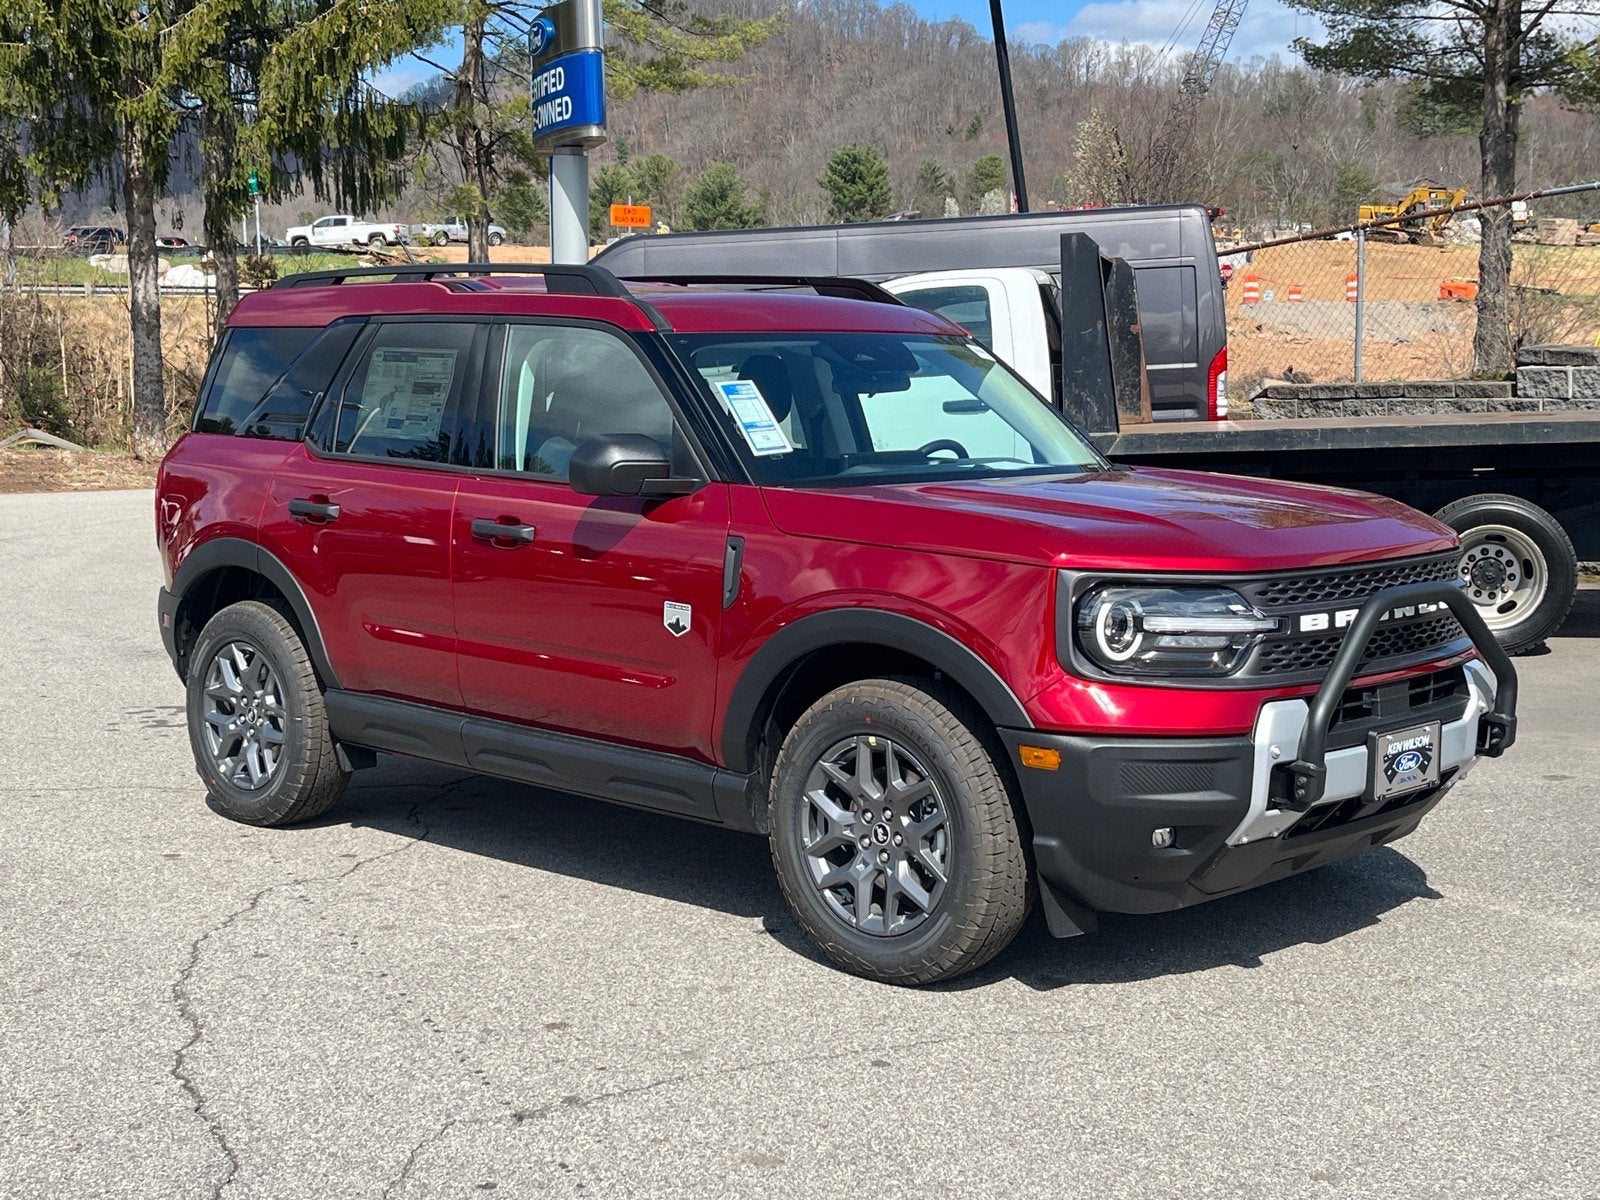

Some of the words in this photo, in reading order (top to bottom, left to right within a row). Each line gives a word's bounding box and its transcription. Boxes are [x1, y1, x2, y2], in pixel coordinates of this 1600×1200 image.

[1387, 741, 1402, 755] KEN
[1402, 735, 1430, 750] WILSON
[1399, 755, 1417, 770] Ford
